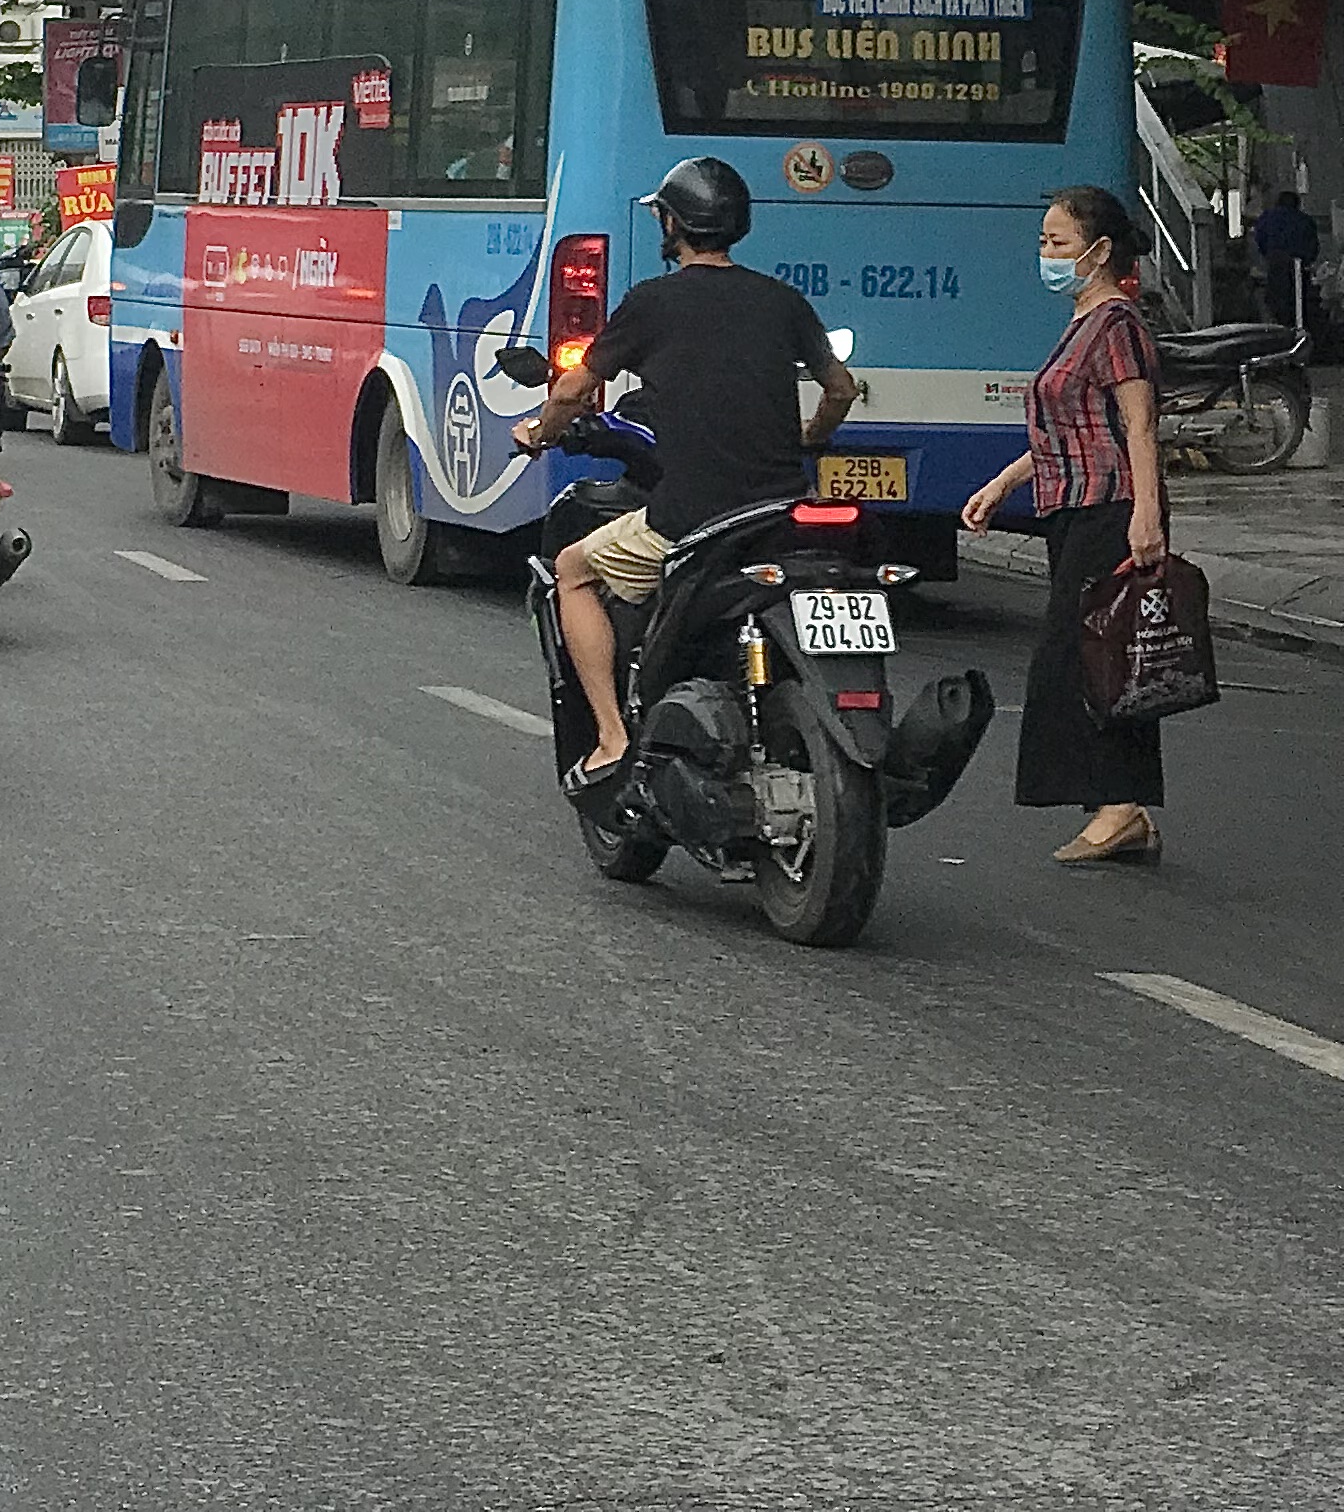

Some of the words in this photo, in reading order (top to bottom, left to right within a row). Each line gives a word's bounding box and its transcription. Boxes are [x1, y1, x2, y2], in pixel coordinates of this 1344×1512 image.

[746, 28, 813, 58] BUS
[827, 20, 900, 60] LIÊN
[914, 32, 1002, 62] NINH
[768, 80, 871, 98] Hotline
[199, 152, 276, 205] BUFFET
[277, 105, 346, 206] 10K
[63, 187, 114, 216] RỬA
[775, 262, 829, 297] 29B
[860, 265, 961, 299] 622.14
[830, 479, 899, 499] 622.14
